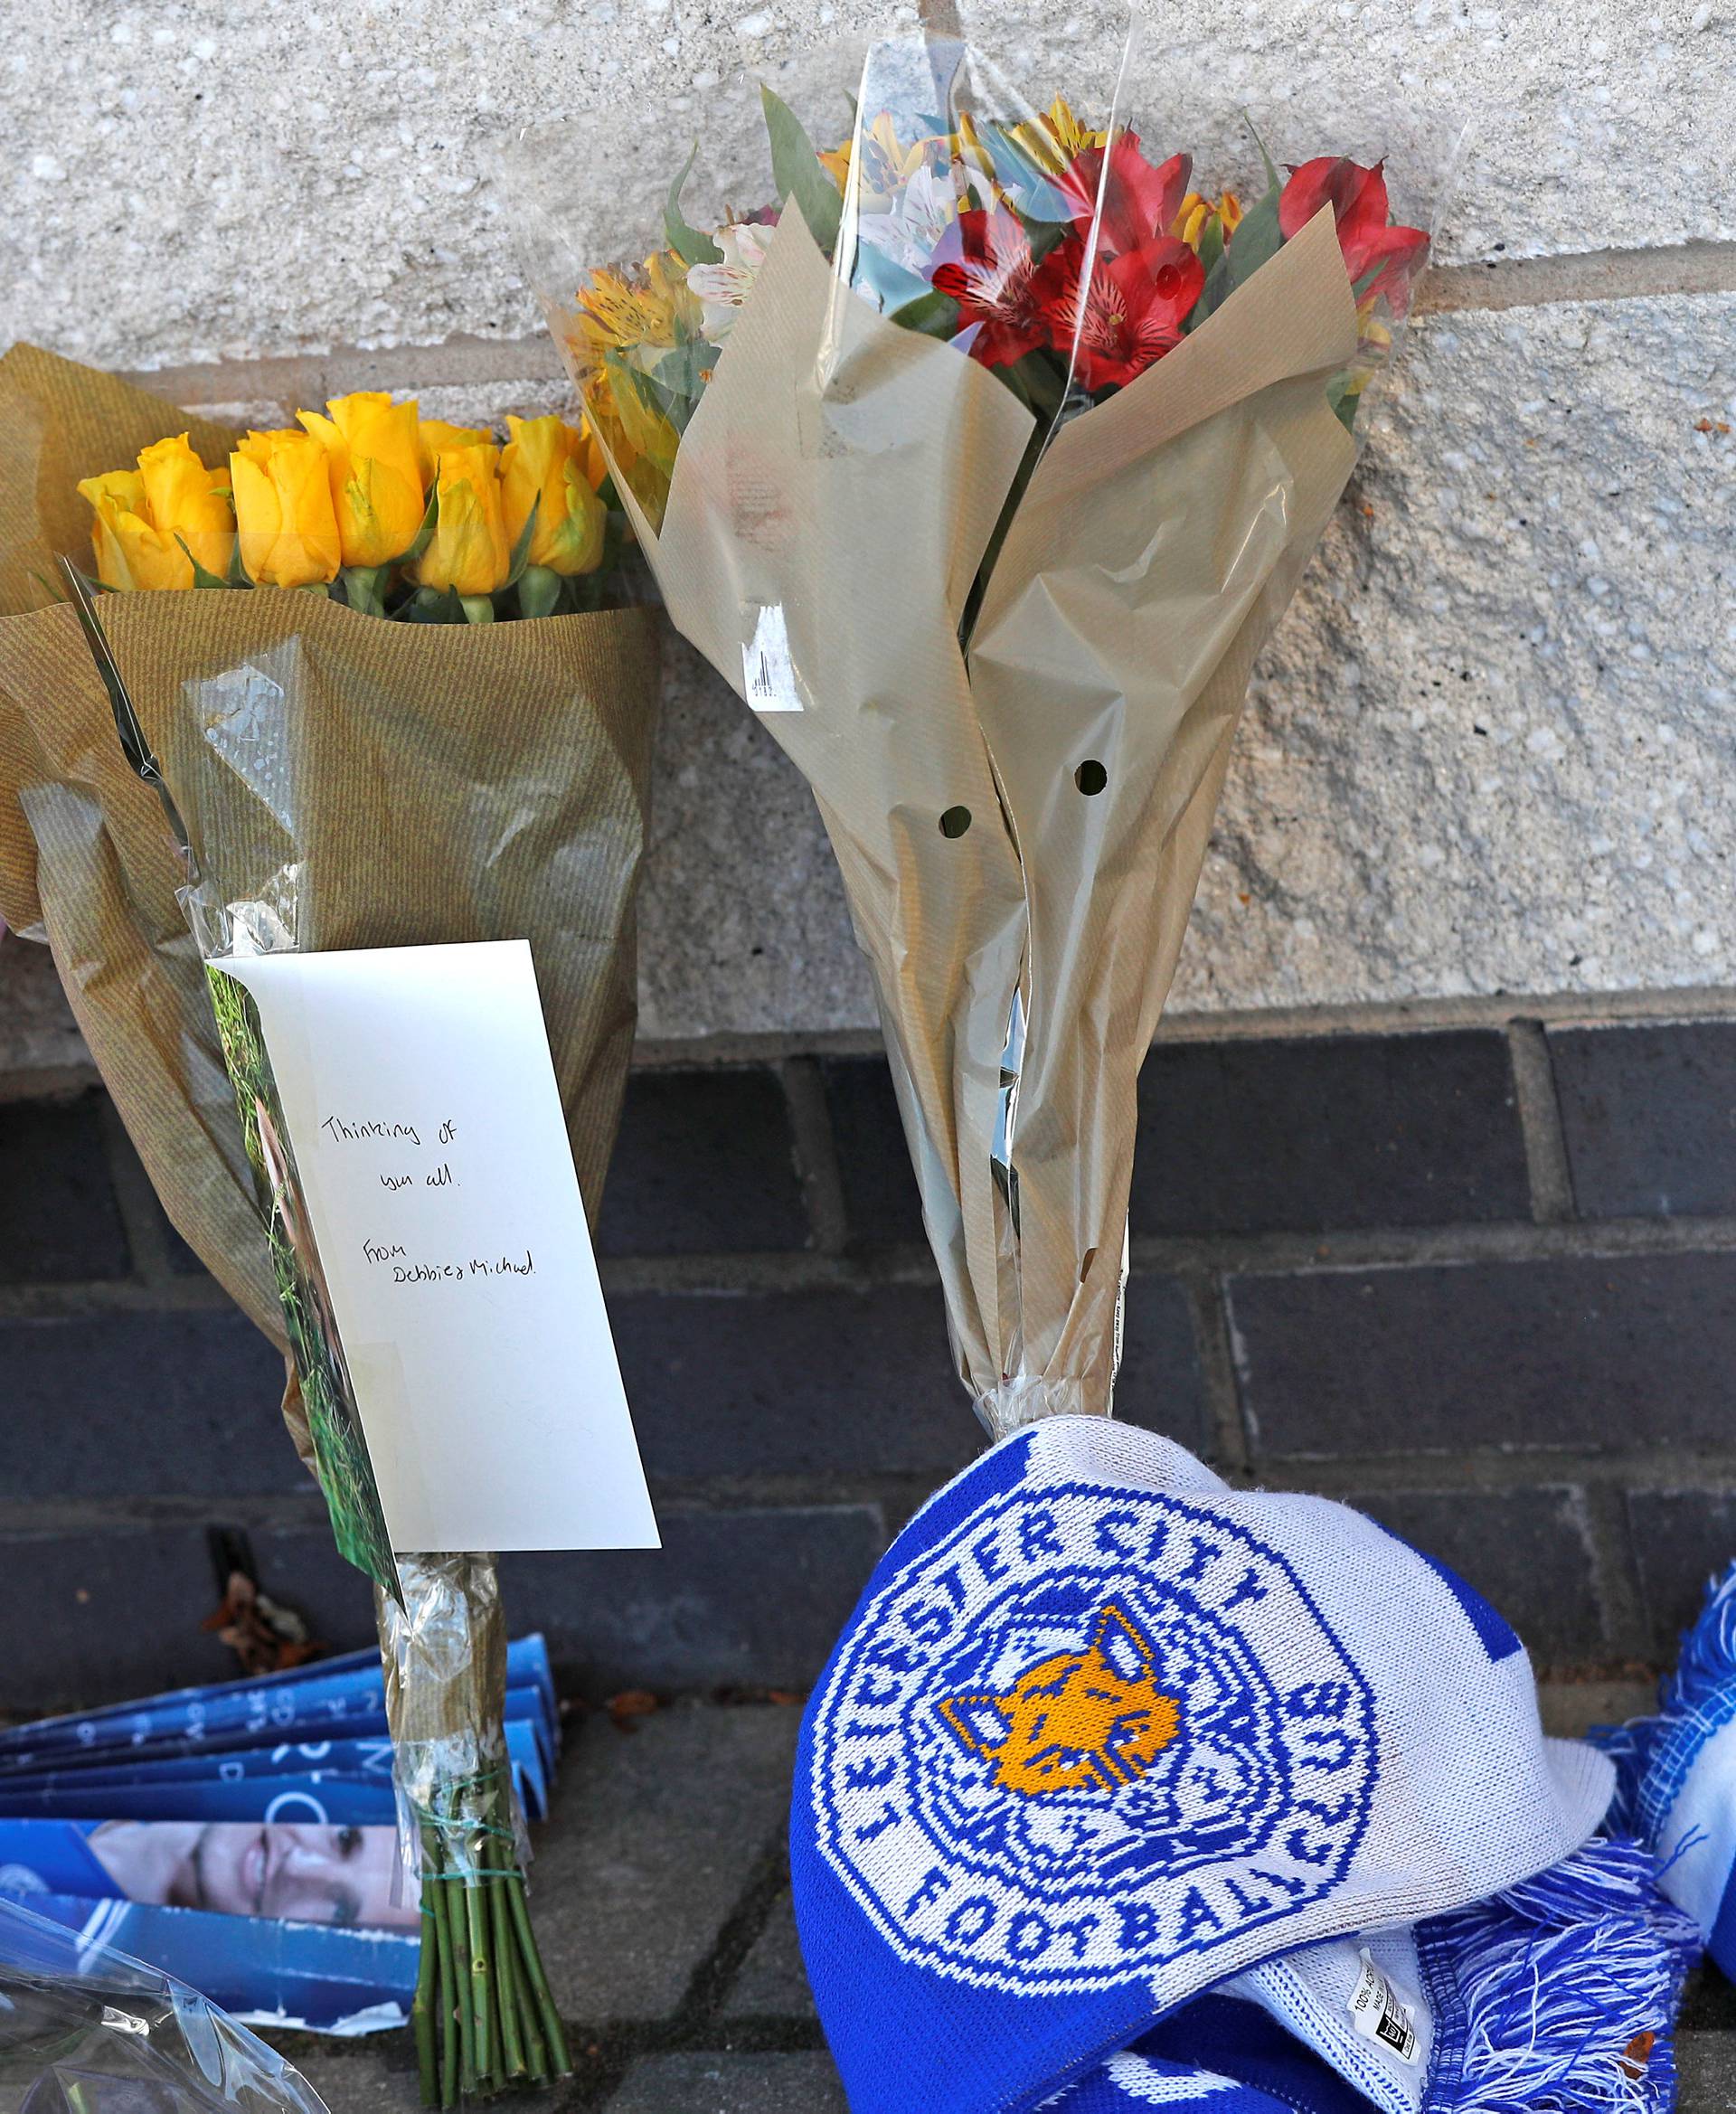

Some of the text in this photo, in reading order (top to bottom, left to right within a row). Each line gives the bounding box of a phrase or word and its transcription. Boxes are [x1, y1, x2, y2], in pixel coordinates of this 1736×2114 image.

[321, 1116, 458, 1146] Thinking of
[363, 1239, 407, 1264] From
[844, 1507, 1268, 1842] LEICESTER CITY
[903, 1680, 1358, 1961] FOOTBALL CLUB
[1354, 1987, 1373, 2013] 100%
[1373, 1990, 1384, 2012] MADE
